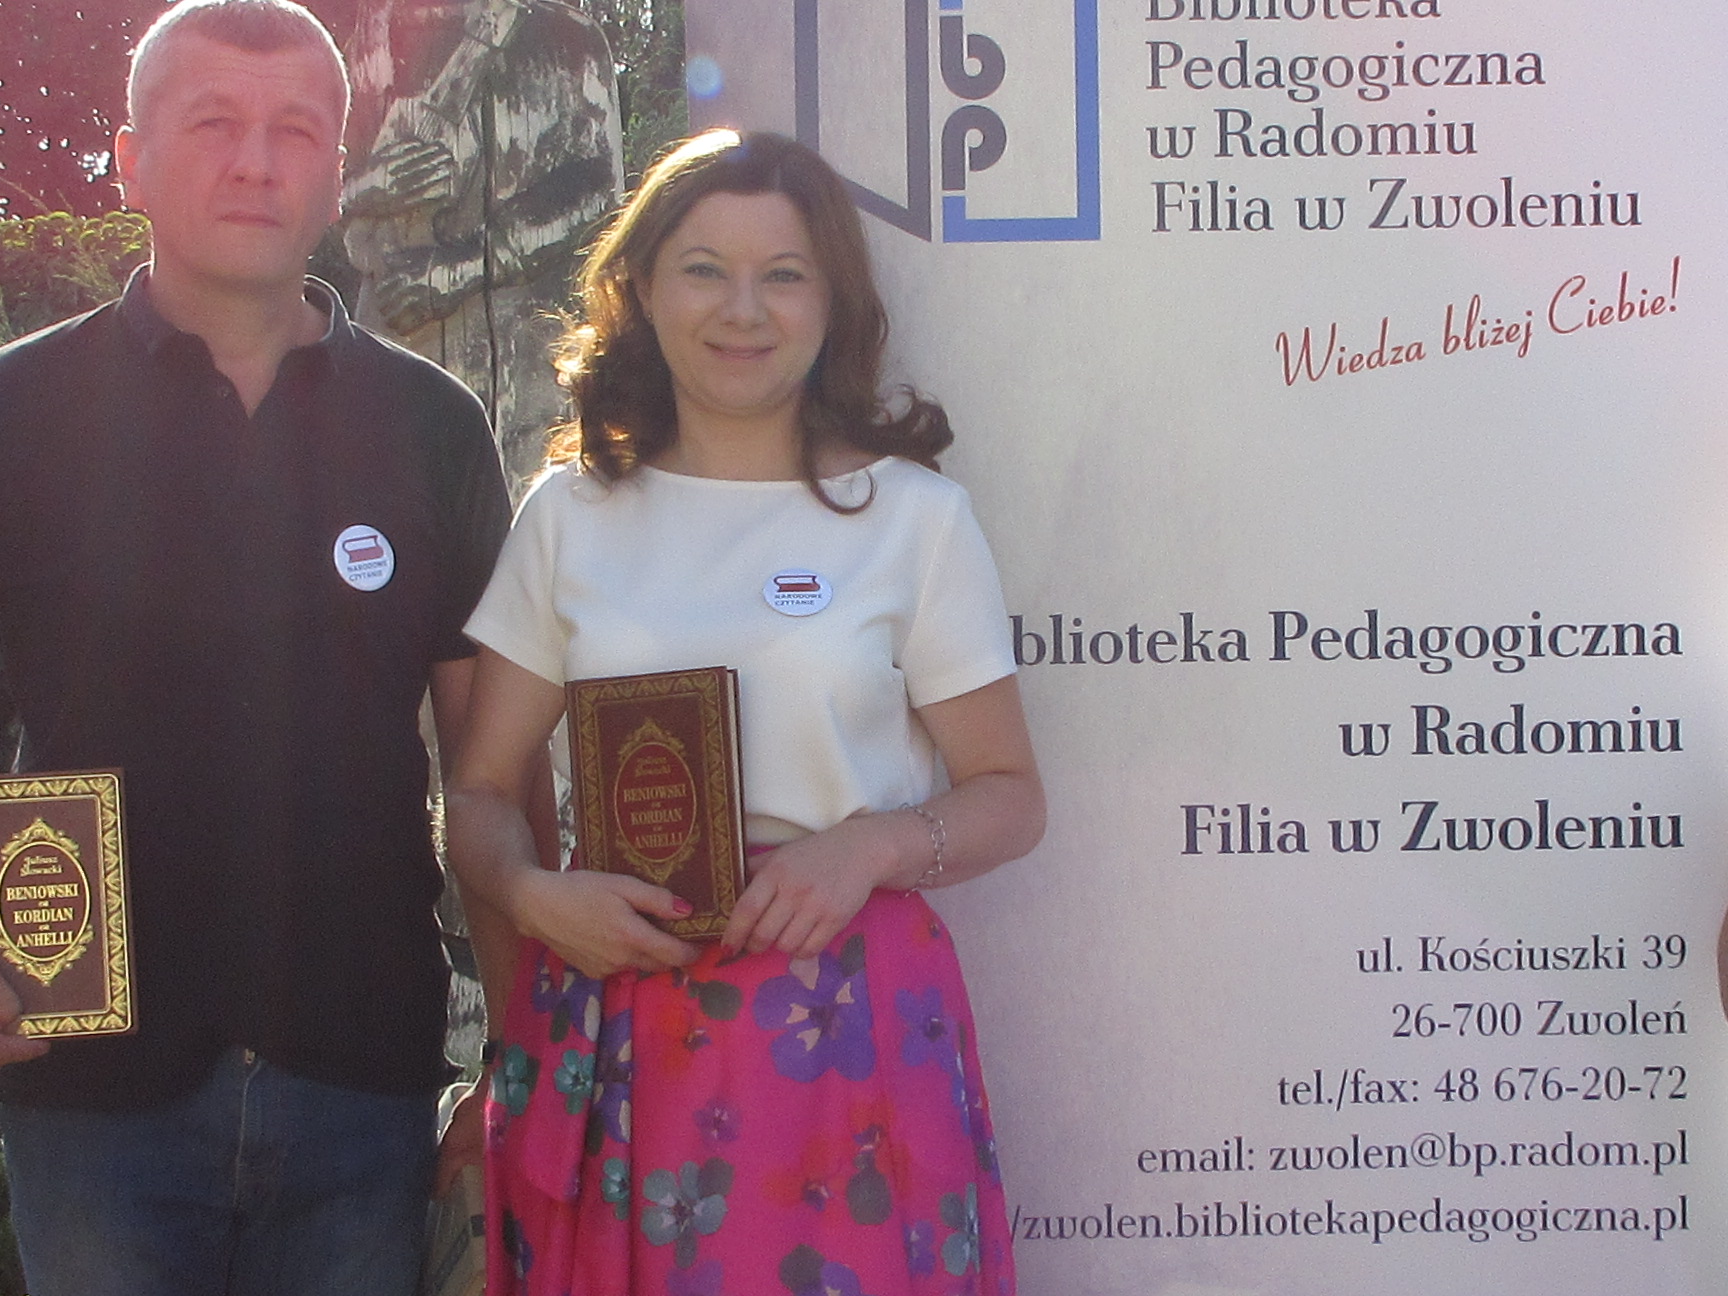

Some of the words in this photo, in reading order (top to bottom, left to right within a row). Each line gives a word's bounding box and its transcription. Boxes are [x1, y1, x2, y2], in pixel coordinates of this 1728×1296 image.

[1146, 39, 1546, 102] Pedagogiczna
[1147, 119, 1196, 159] w
[1214, 108, 1477, 158] Radomiu
[1152, 182, 1274, 232] Filia
[1296, 191, 1347, 231] w
[1369, 178, 1642, 230] Zwoleniu
[1275, 317, 1426, 386] Wiedza
[1442, 294, 1533, 359] bliżej
[1548, 255, 1681, 335] Ciebie!
[1010, 612, 1250, 666] blioteka
[1269, 610, 1684, 673] Pedagogiczna
[1339, 714, 1392, 757] w
[1411, 704, 1684, 757] Radomiu
[623, 784, 687, 802] BENIOWSKI
[631, 808, 683, 825] KORDIAN
[635, 832, 683, 849] ANHELLI
[1180, 805, 1309, 856] Filia
[1330, 813, 1381, 853] w
[1400, 800, 1685, 853] Zwoleniu
[6, 884, 78, 901] BENIOWSKI
[14, 908, 73, 924] KORDIAN
[16, 931, 74, 947] ANHELLI
[1357, 938, 1404, 973] ul.
[1417, 935, 1627, 973] Kościuszki
[1642, 935, 1687, 970] 39
[1392, 1002, 1522, 1039] 26-700
[1537, 1000, 1687, 1036] Zwoleń
[1277, 1069, 1422, 1114] tel./fax:
[1434, 1069, 1479, 1105] 48
[1493, 1066, 1688, 1104] 676-20-72
[1137, 1138, 1257, 1175] email:
[1269, 1131, 1689, 1179] zwolen@bp.radom.pl
[1009, 1197, 1690, 1246] /zwolen.bibliotekapedagogiczna.pl
